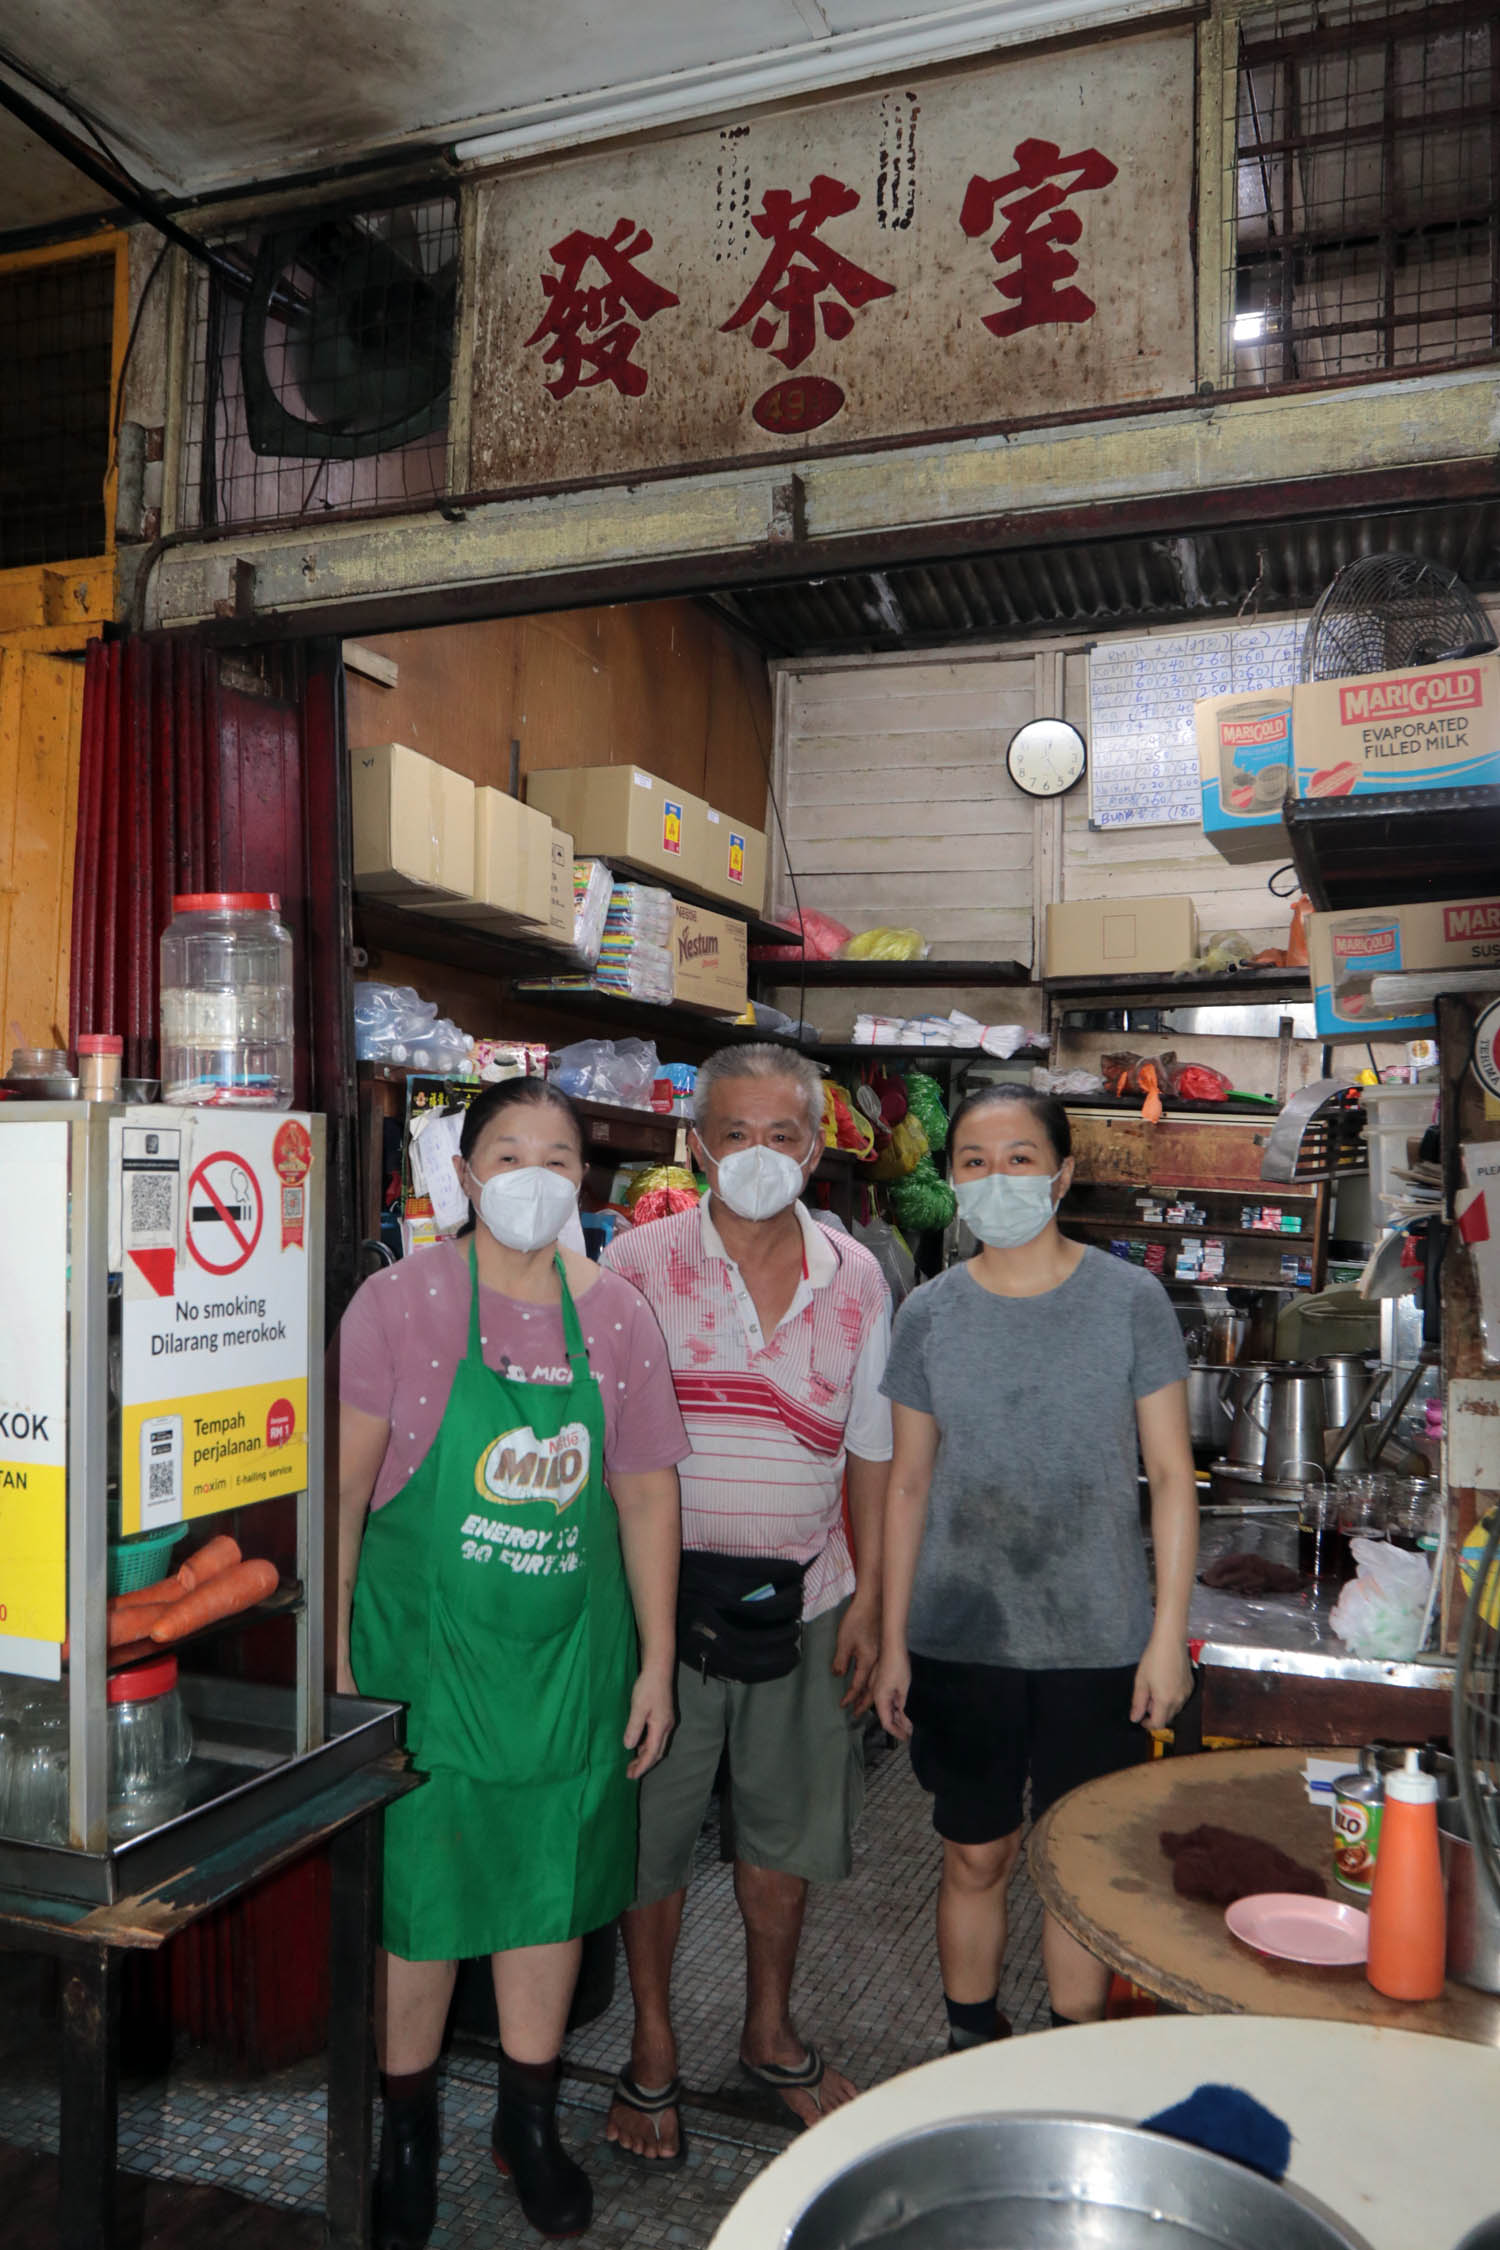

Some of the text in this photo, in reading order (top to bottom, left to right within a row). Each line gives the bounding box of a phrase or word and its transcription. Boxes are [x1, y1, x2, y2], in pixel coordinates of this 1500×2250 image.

[1345, 674, 1476, 720] MARIGOLD
[1223, 722, 1284, 745] MARIGOLD
[1362, 716, 1469, 744] EVAPORATED
[1364, 733, 1469, 759] FILLED MILK
[678, 926, 719, 964] Nestum
[176, 1295, 266, 1322] No smoking
[151, 1320, 286, 1356] Dilarang merokok
[193, 1411, 245, 1437] Tempah
[193, 1437, 261, 1467] perjalanan
[269, 1465, 293, 1478] service
[493, 1448, 583, 1490] MILO
[460, 1514, 553, 1551] ENERGY
